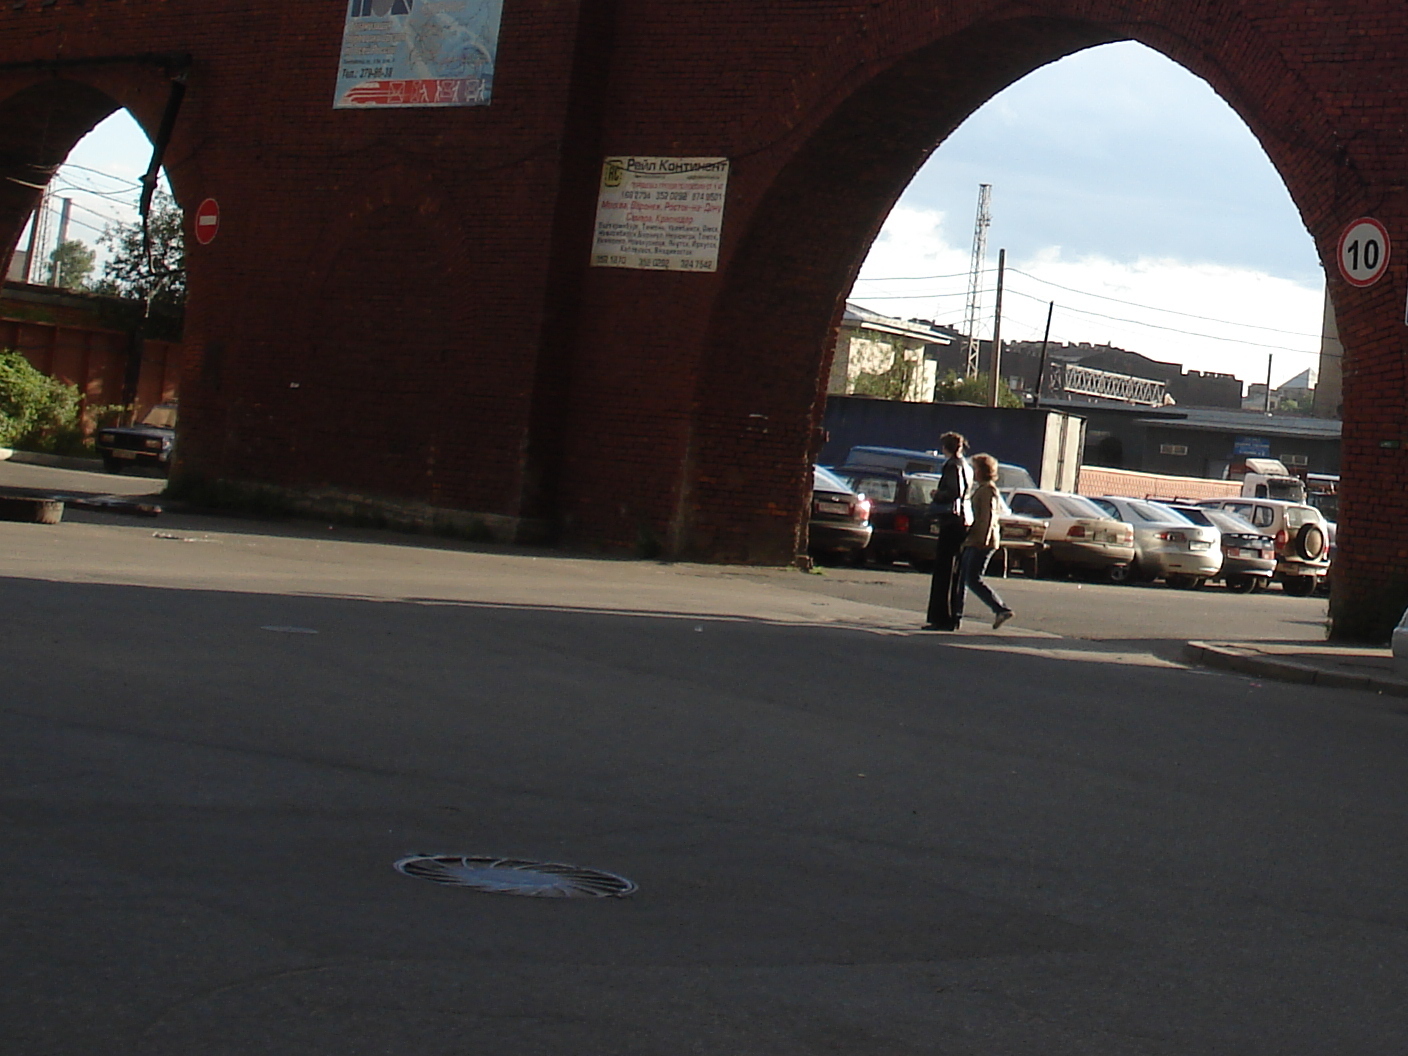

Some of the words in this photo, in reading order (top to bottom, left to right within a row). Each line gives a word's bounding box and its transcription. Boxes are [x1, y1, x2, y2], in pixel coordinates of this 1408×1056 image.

[627, 159, 656, 172] Рейл
[659, 160, 728, 173] Континент
[1347, 239, 1379, 270] 10
